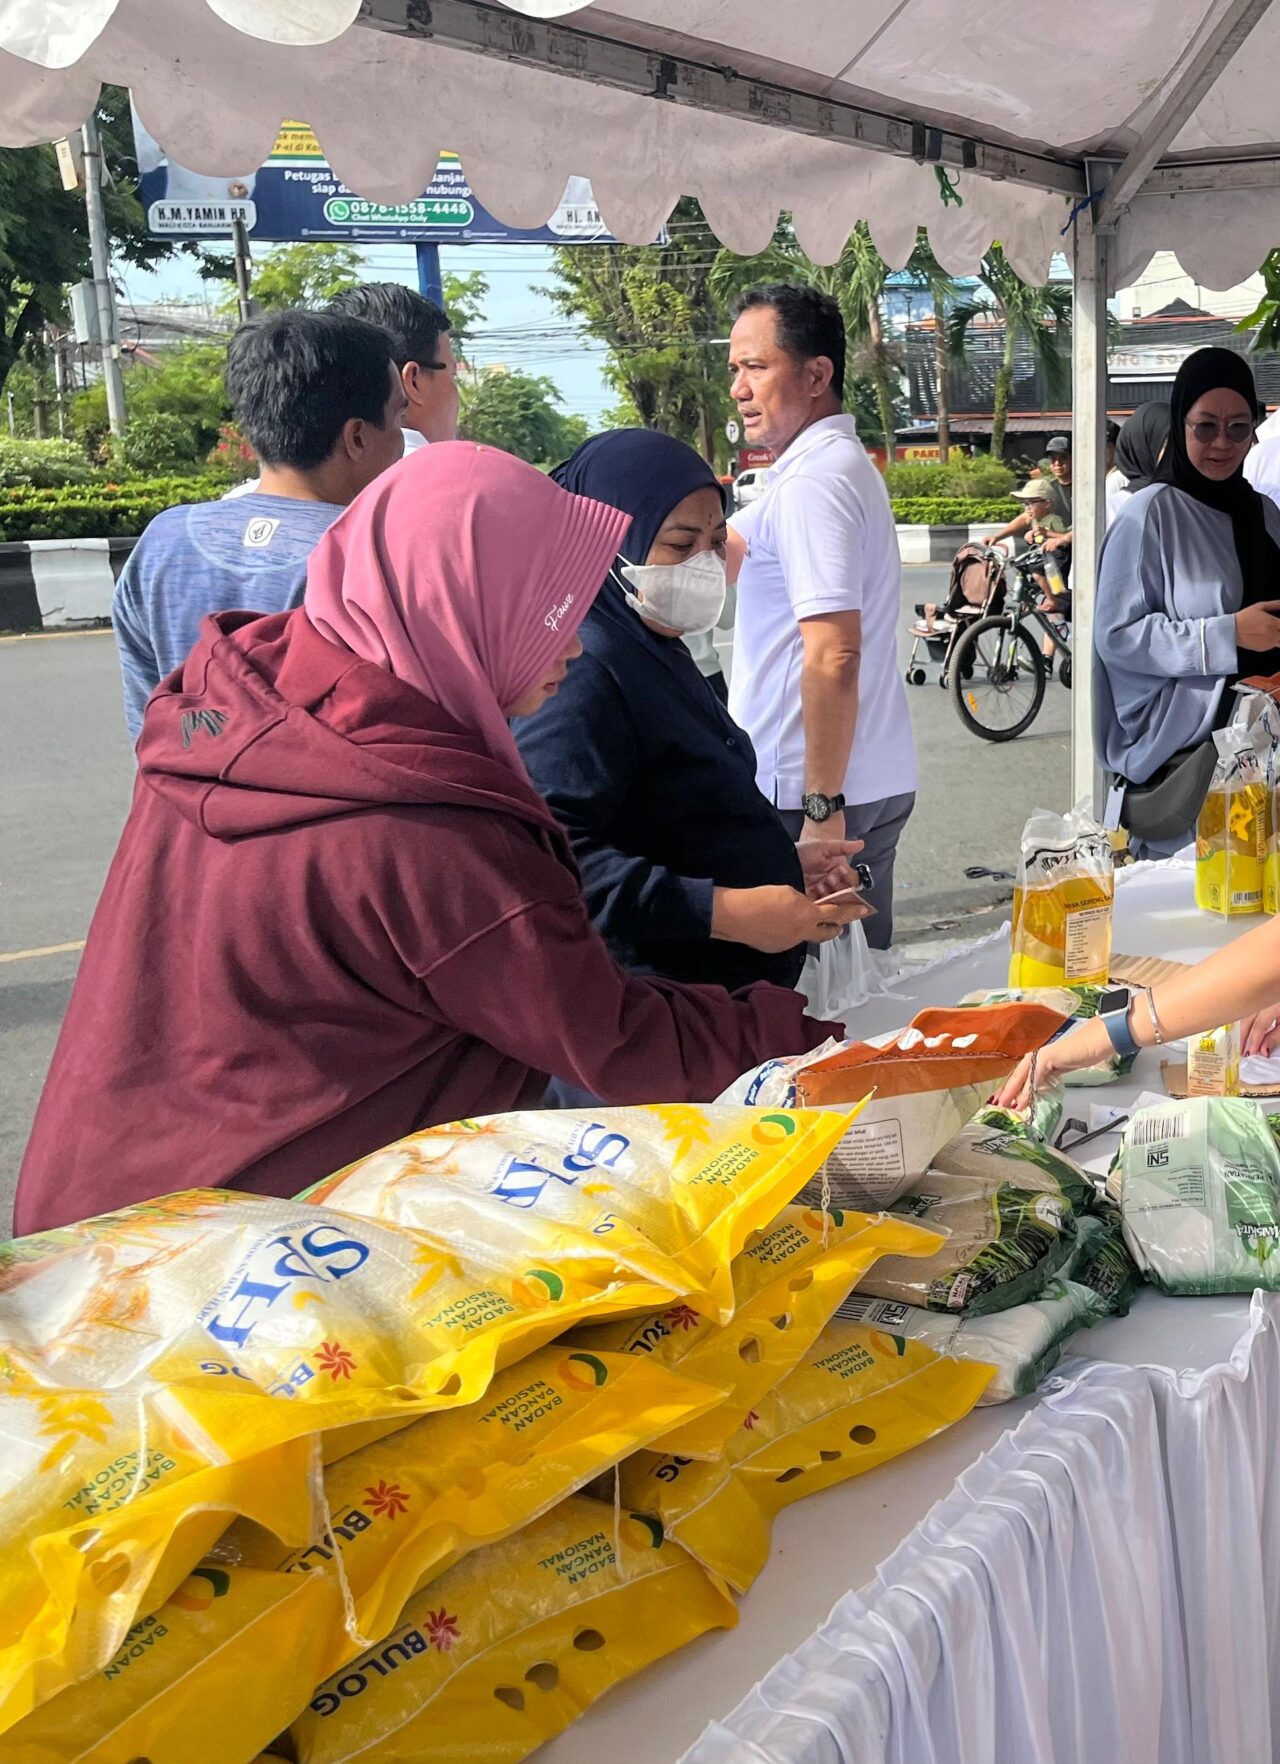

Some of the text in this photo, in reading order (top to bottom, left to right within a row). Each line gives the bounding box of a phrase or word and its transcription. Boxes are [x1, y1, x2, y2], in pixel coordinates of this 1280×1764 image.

[284, 170, 331, 182] Petugas
[311, 184, 336, 195] siap
[688, 1142, 743, 1185] NASIONAL
[706, 1146, 752, 1186] PANGAN
[720, 1150, 760, 1187] BADAN
[1147, 1150, 1169, 1167] SNI
[744, 1223, 795, 1258] NASIONAL
[758, 1229, 803, 1264] PANGAN
[771, 1235, 810, 1265] BADAN
[206, 1225, 370, 1349] SPH
[194, 1297, 220, 1325] HARG
[445, 1297, 507, 1329] PANGAN
[463, 1304, 514, 1331] BADAN
[811, 1343, 862, 1369] NASIONAL
[827, 1349, 870, 1374] PANGAN
[838, 1356, 876, 1379] BADAN
[476, 1380, 547, 1424] NASIONAL
[500, 1388, 556, 1425] PANGAN
[514, 1396, 564, 1432] BADAN
[63, 1448, 154, 1510] ASIONAL
[537, 1531, 606, 1570] NASIONAL
[555, 1541, 612, 1577] PANGAN
[567, 1552, 617, 1585] BADAN
[104, 1625, 168, 1680] BADAN
[309, 1629, 428, 1717] BULOG
